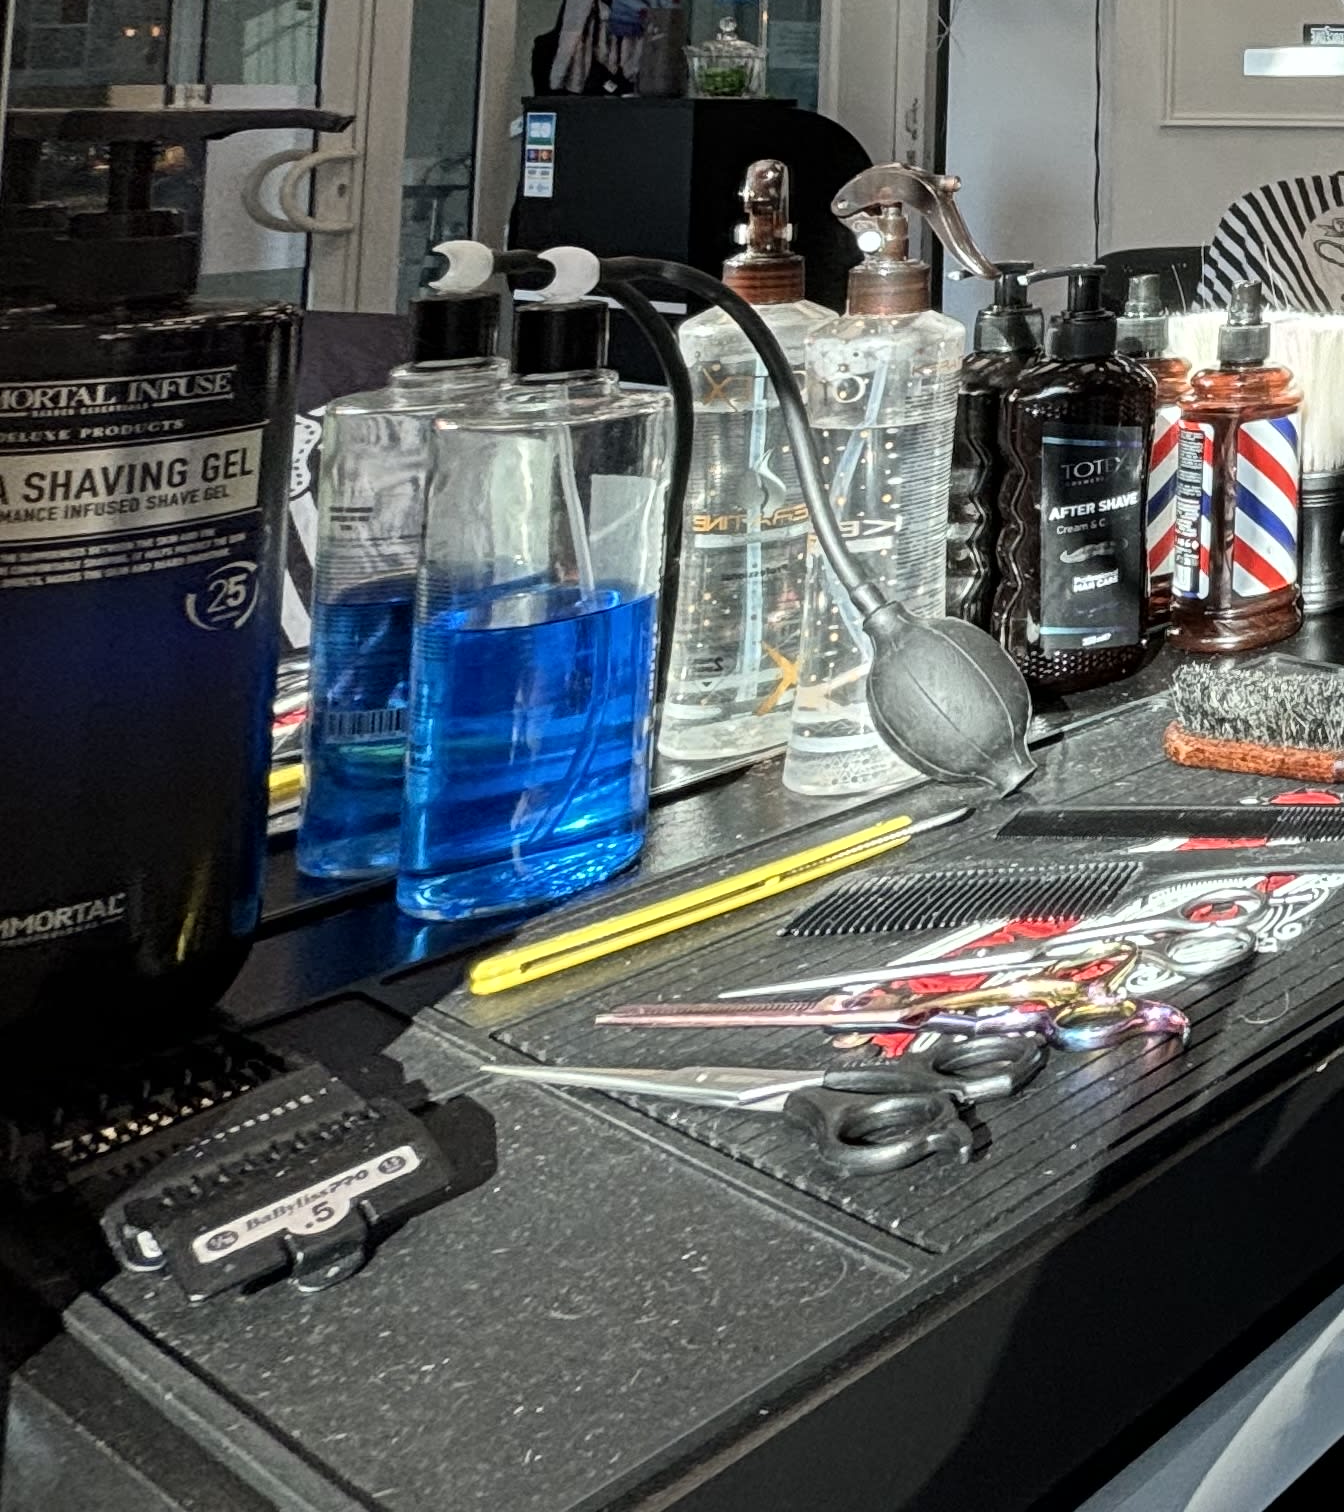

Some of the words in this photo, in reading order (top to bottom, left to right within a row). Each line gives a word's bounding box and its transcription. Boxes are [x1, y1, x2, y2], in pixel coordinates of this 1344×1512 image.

[128, 373, 231, 402] INFUSE
[22, 457, 190, 504] SHAVING
[201, 447, 254, 484] GEL
[64, 498, 140, 520] INFUSED
[146, 491, 199, 510] SHAVE
[1048, 502, 1096, 521] AFTER
[1098, 491, 1139, 512] SHAVE
[207, 574, 249, 613] 25
